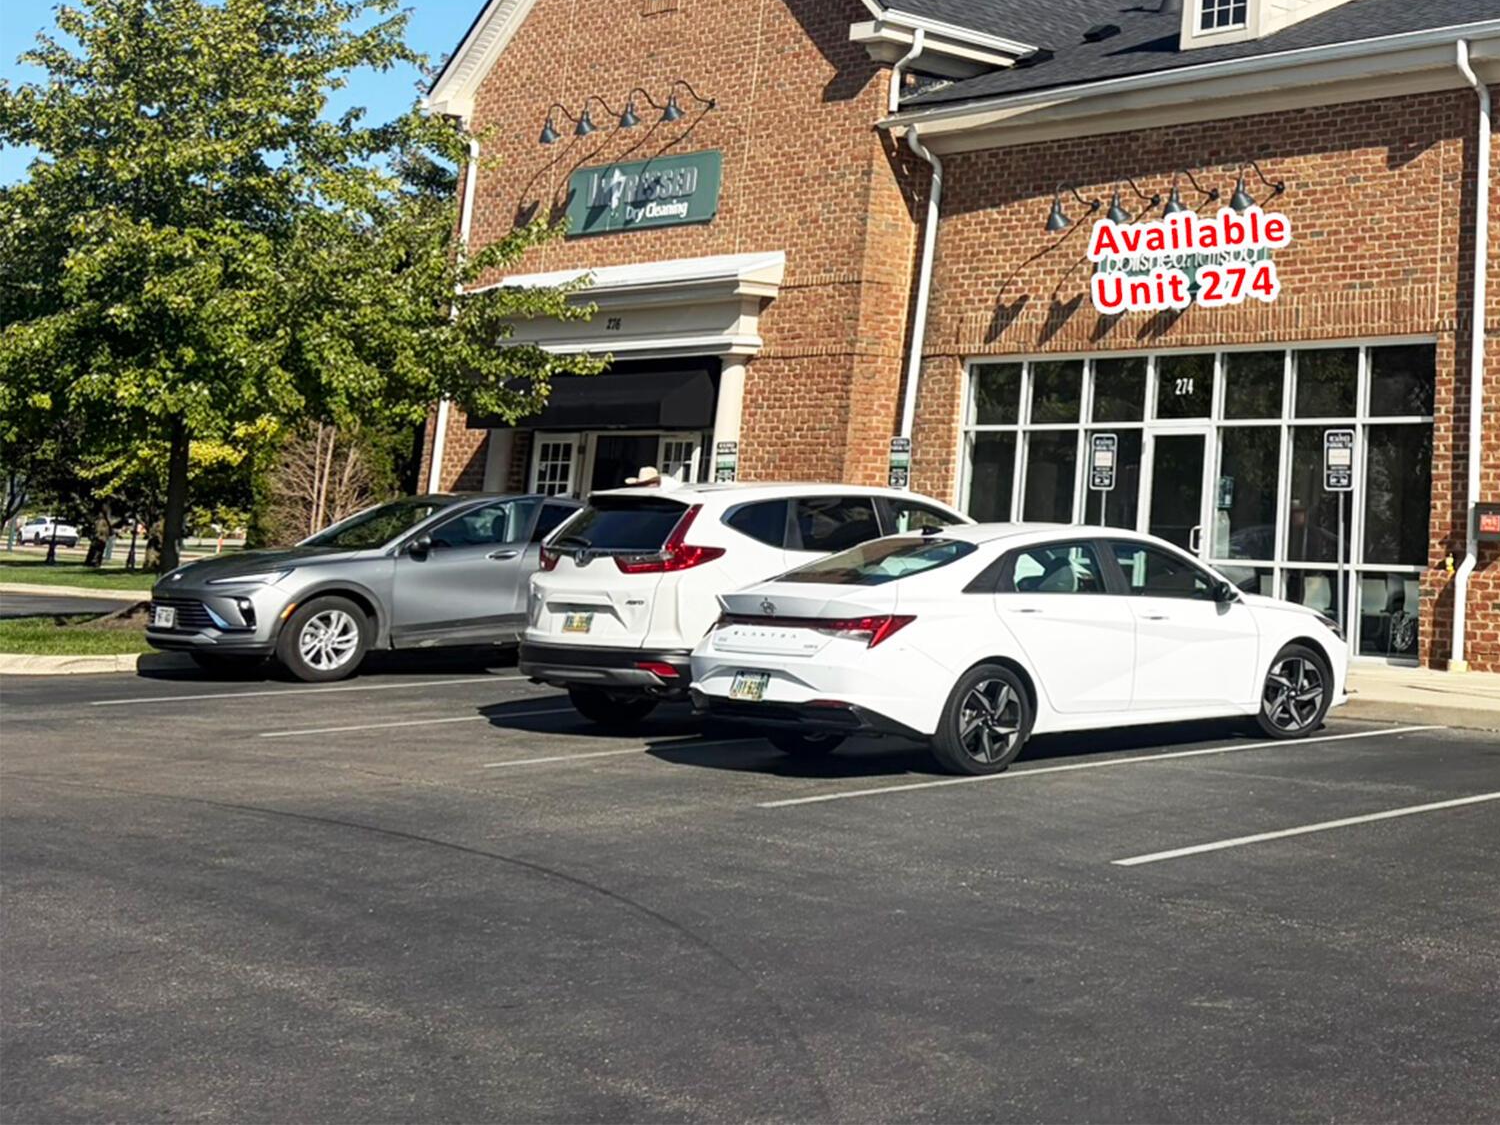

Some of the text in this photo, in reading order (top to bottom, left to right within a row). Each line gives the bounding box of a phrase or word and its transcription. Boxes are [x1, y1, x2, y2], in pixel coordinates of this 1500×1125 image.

[626, 199, 688, 222] Dry Cleaning
[1175, 378, 1194, 395] 274
[733, 630, 798, 639] ELANTRA
